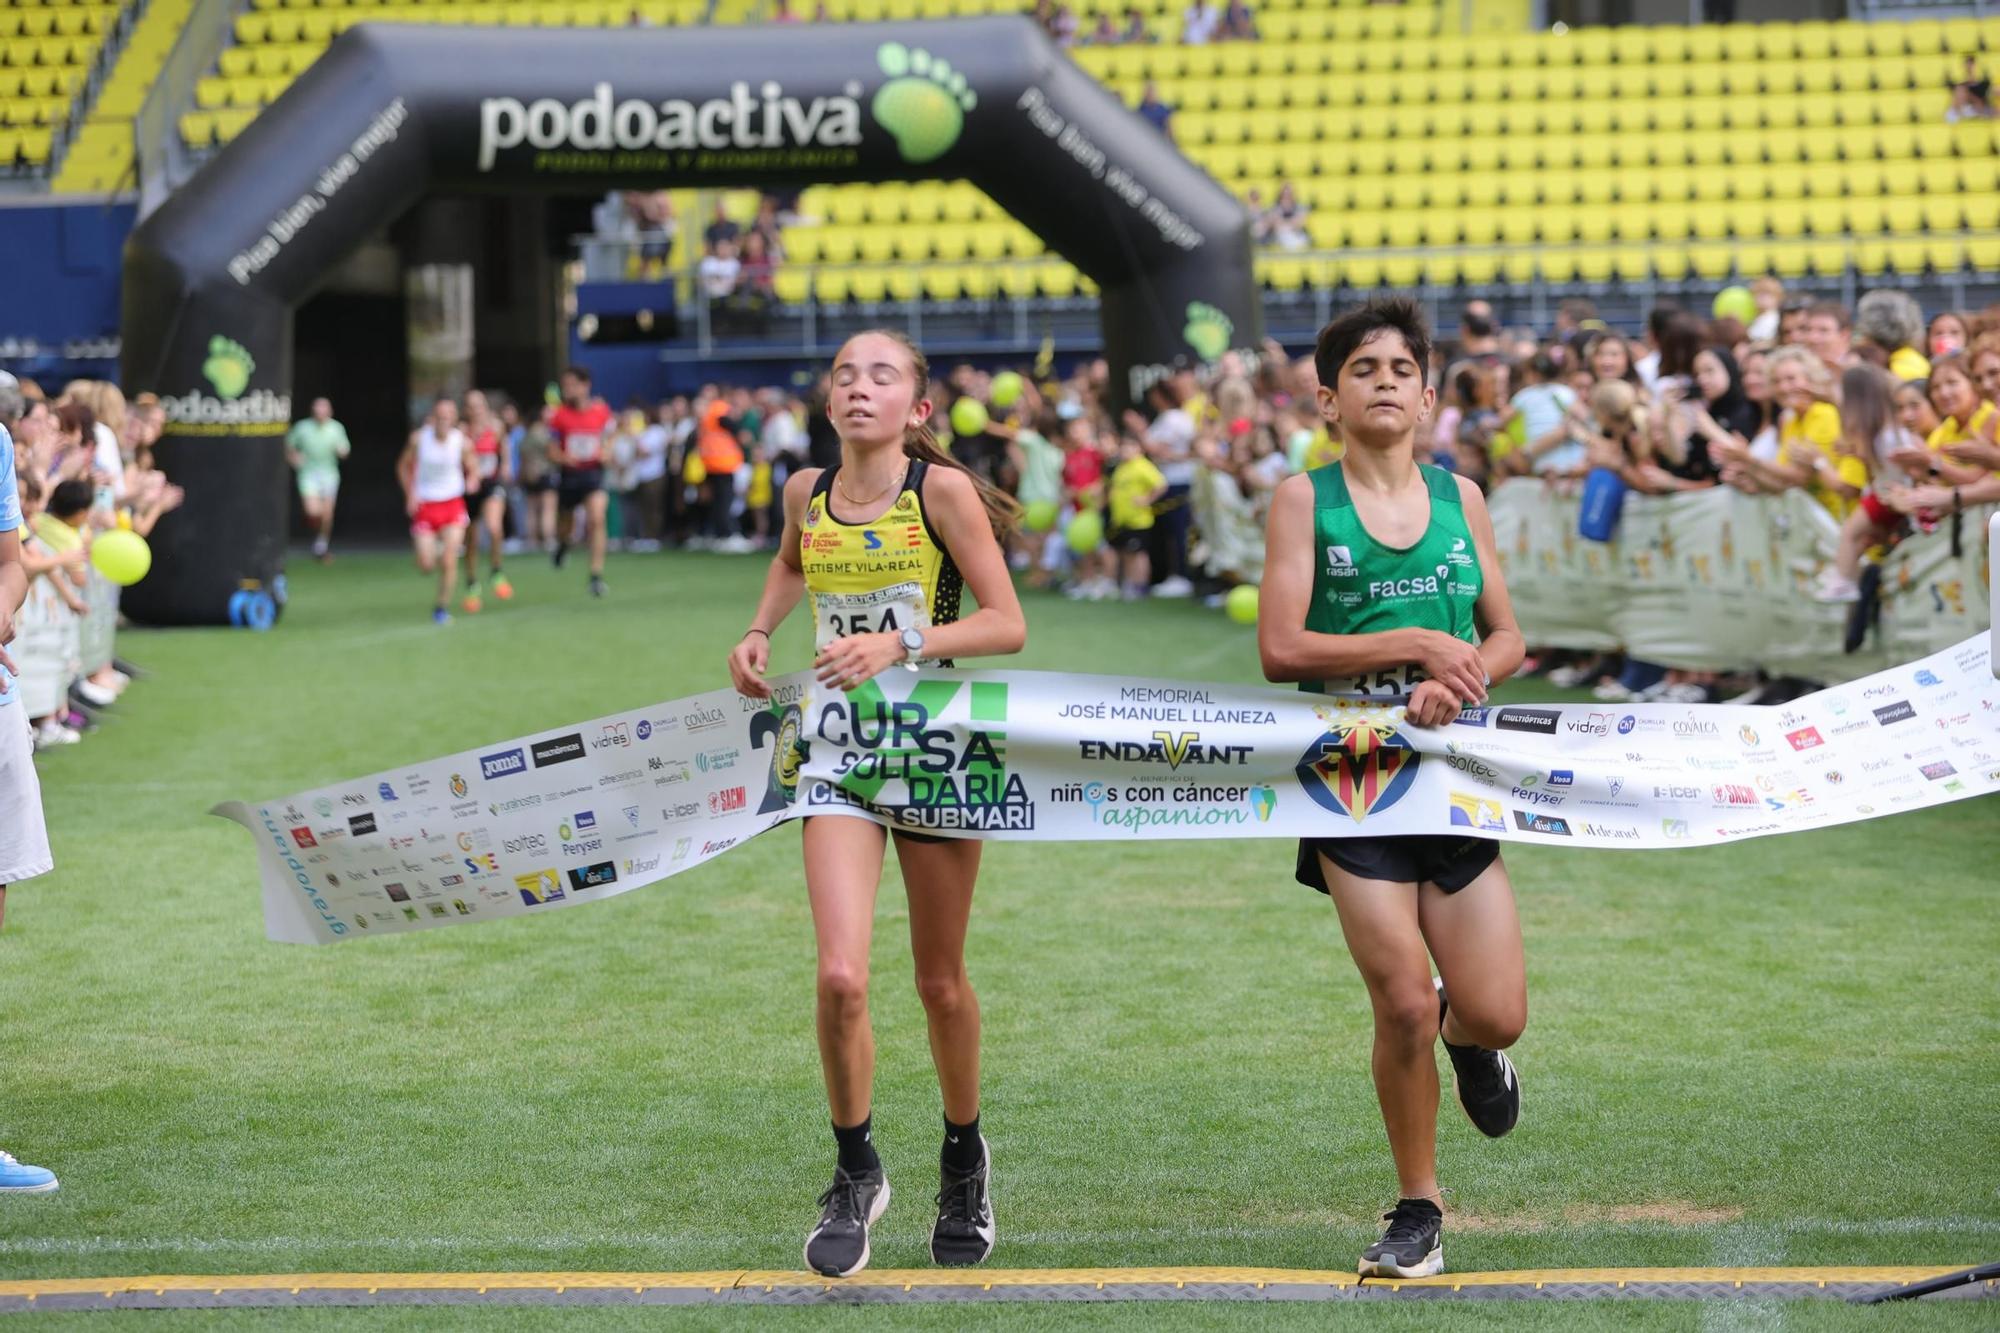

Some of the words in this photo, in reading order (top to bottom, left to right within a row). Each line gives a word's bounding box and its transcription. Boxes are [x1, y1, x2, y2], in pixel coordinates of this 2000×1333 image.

[479, 81, 862, 171] podoactiva
[775, 684, 804, 704] 2024
[1121, 688, 1215, 704] MEMORIAL
[684, 708, 725, 728] COVALCA
[1059, 702, 1106, 719] JOSÉ
[1110, 706, 1187, 722] MANUEL
[1192, 707, 1277, 725] LLANEZA
[1567, 719, 1608, 734] vidres
[592, 732, 627, 750] vidres
[1079, 731, 1254, 771] ENDAVANT
[1126, 786, 1164, 802] con
[1171, 782, 1249, 802] cáncer
[1512, 785, 1565, 805] Peryser
[902, 802, 1033, 831] SUBMARÍ
[1102, 806, 1249, 834] aspanion
